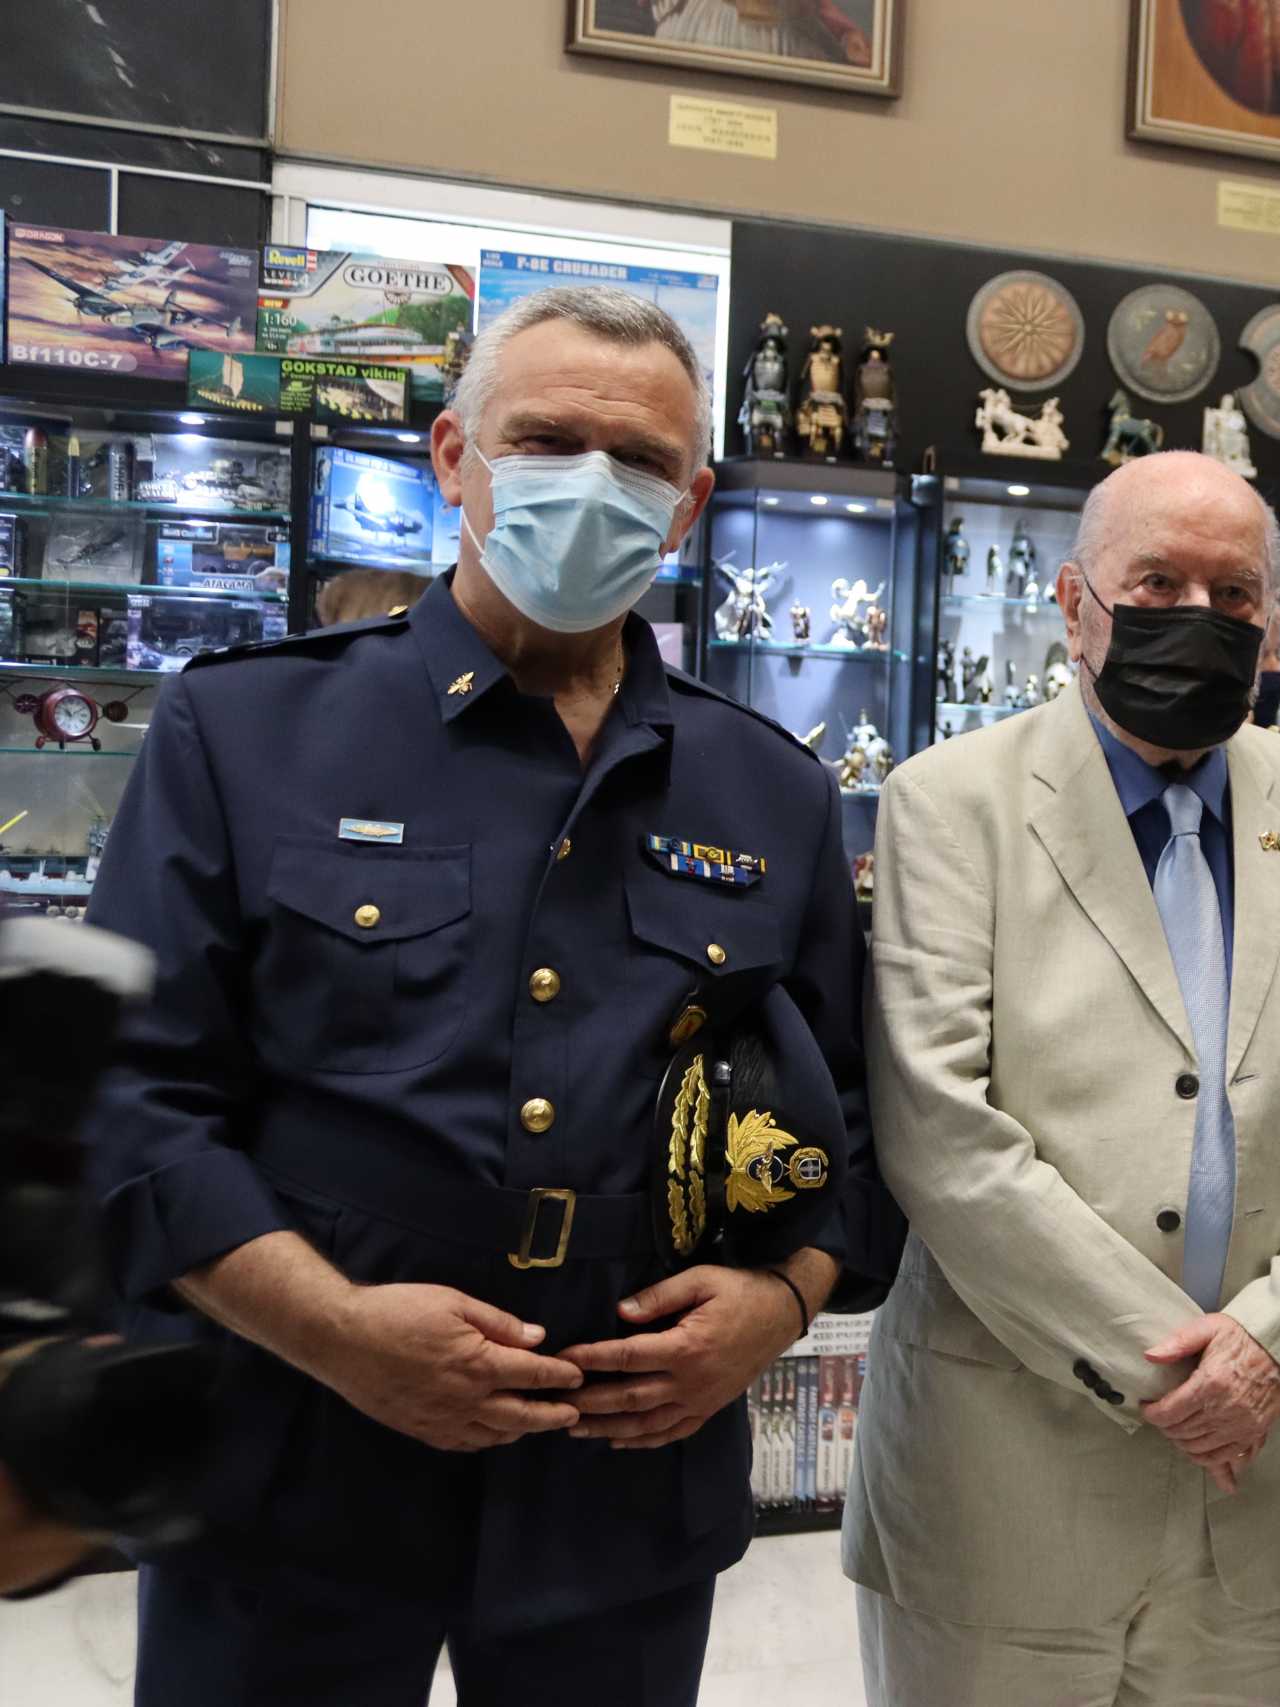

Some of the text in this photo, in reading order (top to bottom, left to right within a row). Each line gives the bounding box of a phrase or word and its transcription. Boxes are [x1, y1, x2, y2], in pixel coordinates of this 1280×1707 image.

[269, 248, 305, 266] Revell
[264, 271, 298, 280] LEVEL
[350, 268, 446, 290] GOETHE
[553, 260, 628, 280] CRUSADER
[264, 312, 297, 327] 1:160
[281, 360, 357, 377] GOKSTAD
[361, 368, 407, 384] viking
